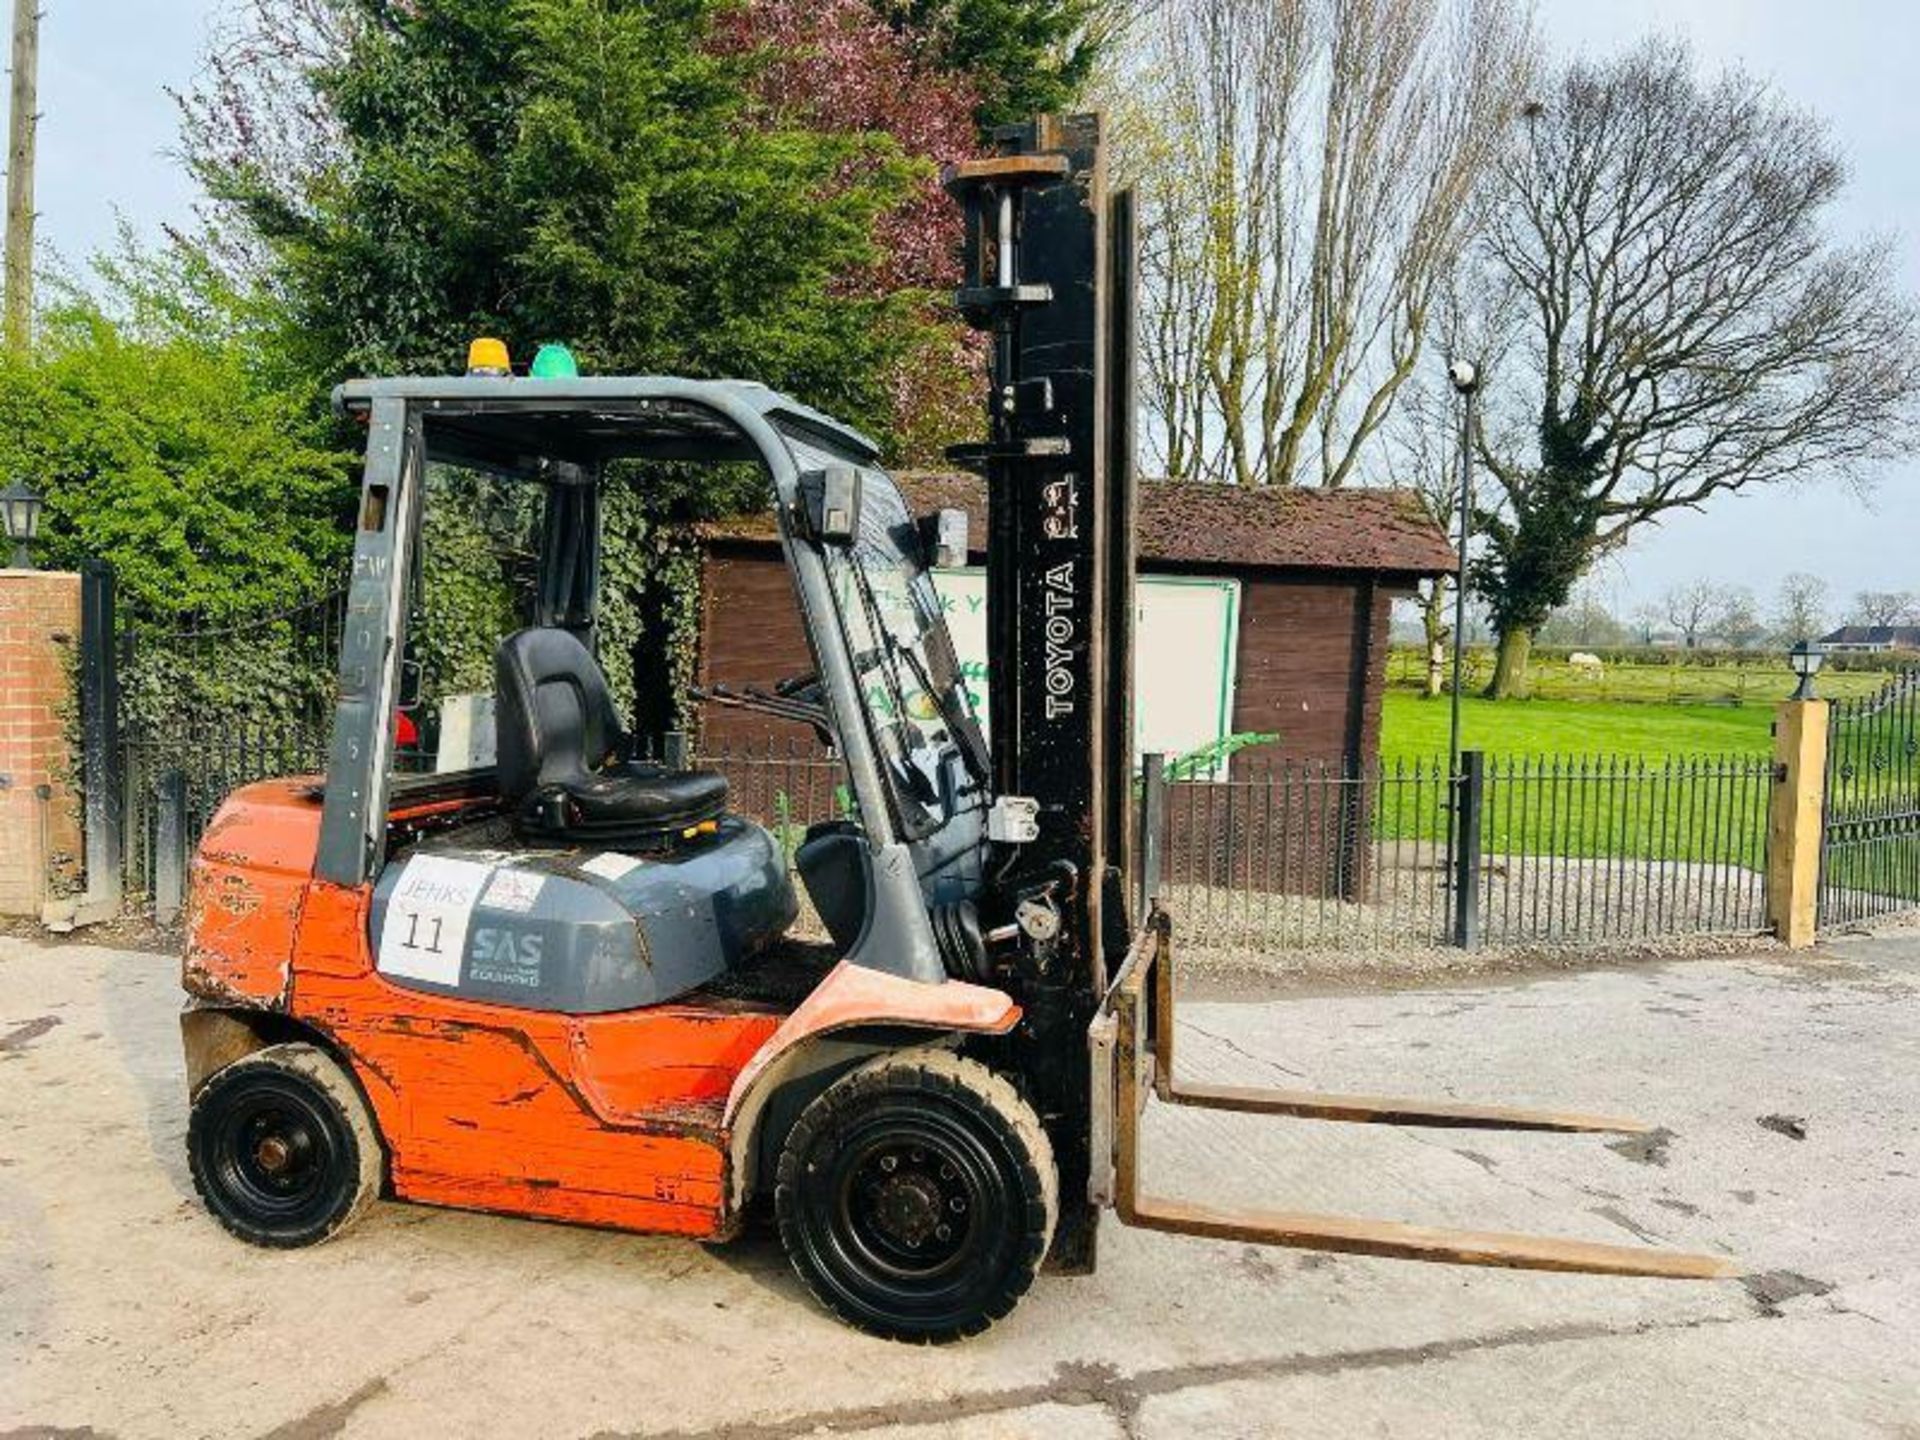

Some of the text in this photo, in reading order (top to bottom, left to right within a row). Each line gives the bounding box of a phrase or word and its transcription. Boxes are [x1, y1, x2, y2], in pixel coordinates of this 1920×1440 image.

[872, 589, 956, 613] Thak
[1045, 561, 1075, 719] TOYOTA
[402, 913, 443, 954] 11
[472, 928, 543, 965] SAS
